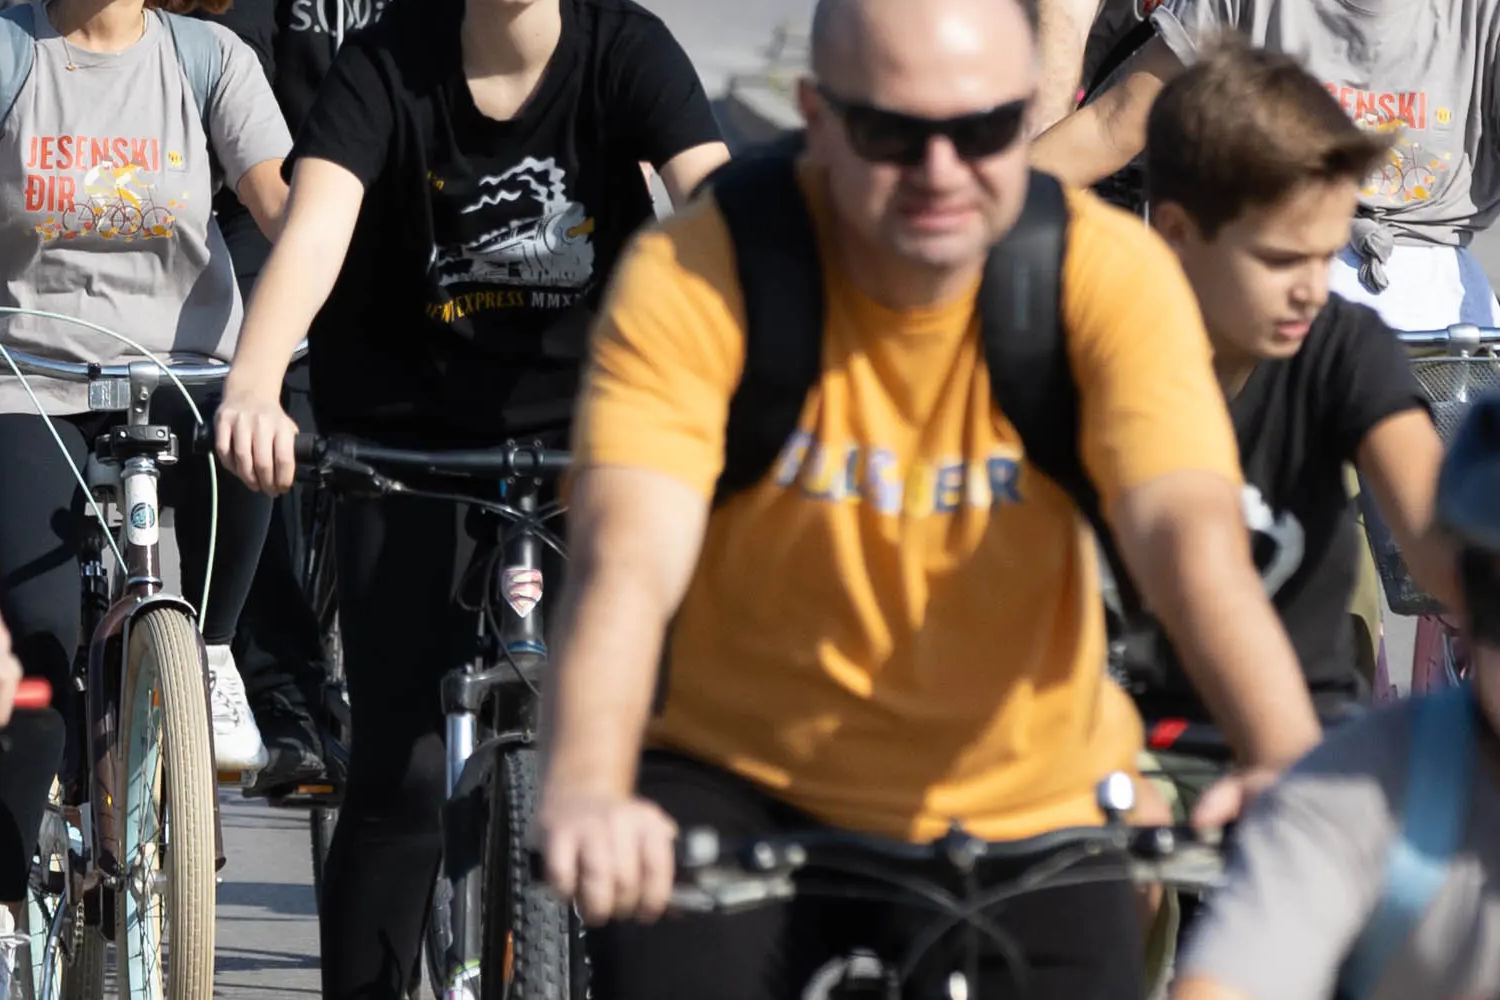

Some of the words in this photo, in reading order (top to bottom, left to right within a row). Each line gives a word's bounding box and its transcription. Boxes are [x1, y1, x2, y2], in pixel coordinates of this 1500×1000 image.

[27, 135, 160, 172] JESENSKI
[25, 174, 77, 213] ĐIR
[454, 291, 525, 318] EXPRESS
